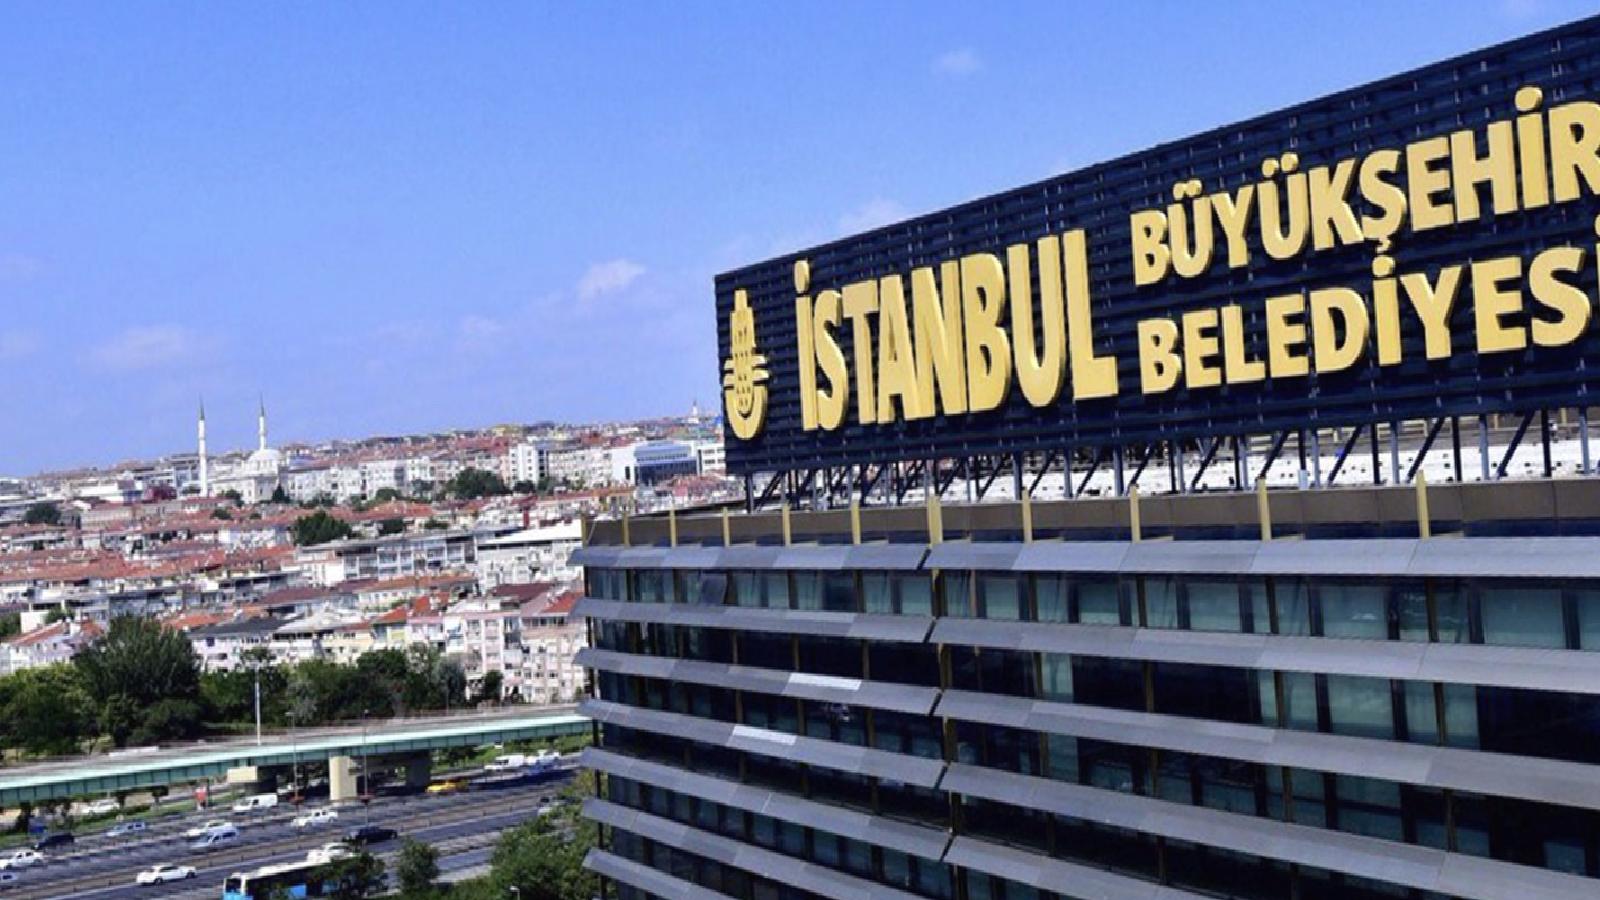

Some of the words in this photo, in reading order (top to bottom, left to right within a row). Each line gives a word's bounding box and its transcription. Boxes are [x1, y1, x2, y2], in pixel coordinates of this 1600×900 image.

[1130, 86, 1600, 287] BÜYÜKŞEHİR
[794, 229, 1118, 431] İSTANBUL
[1137, 214, 1600, 395] BELEDİYES
